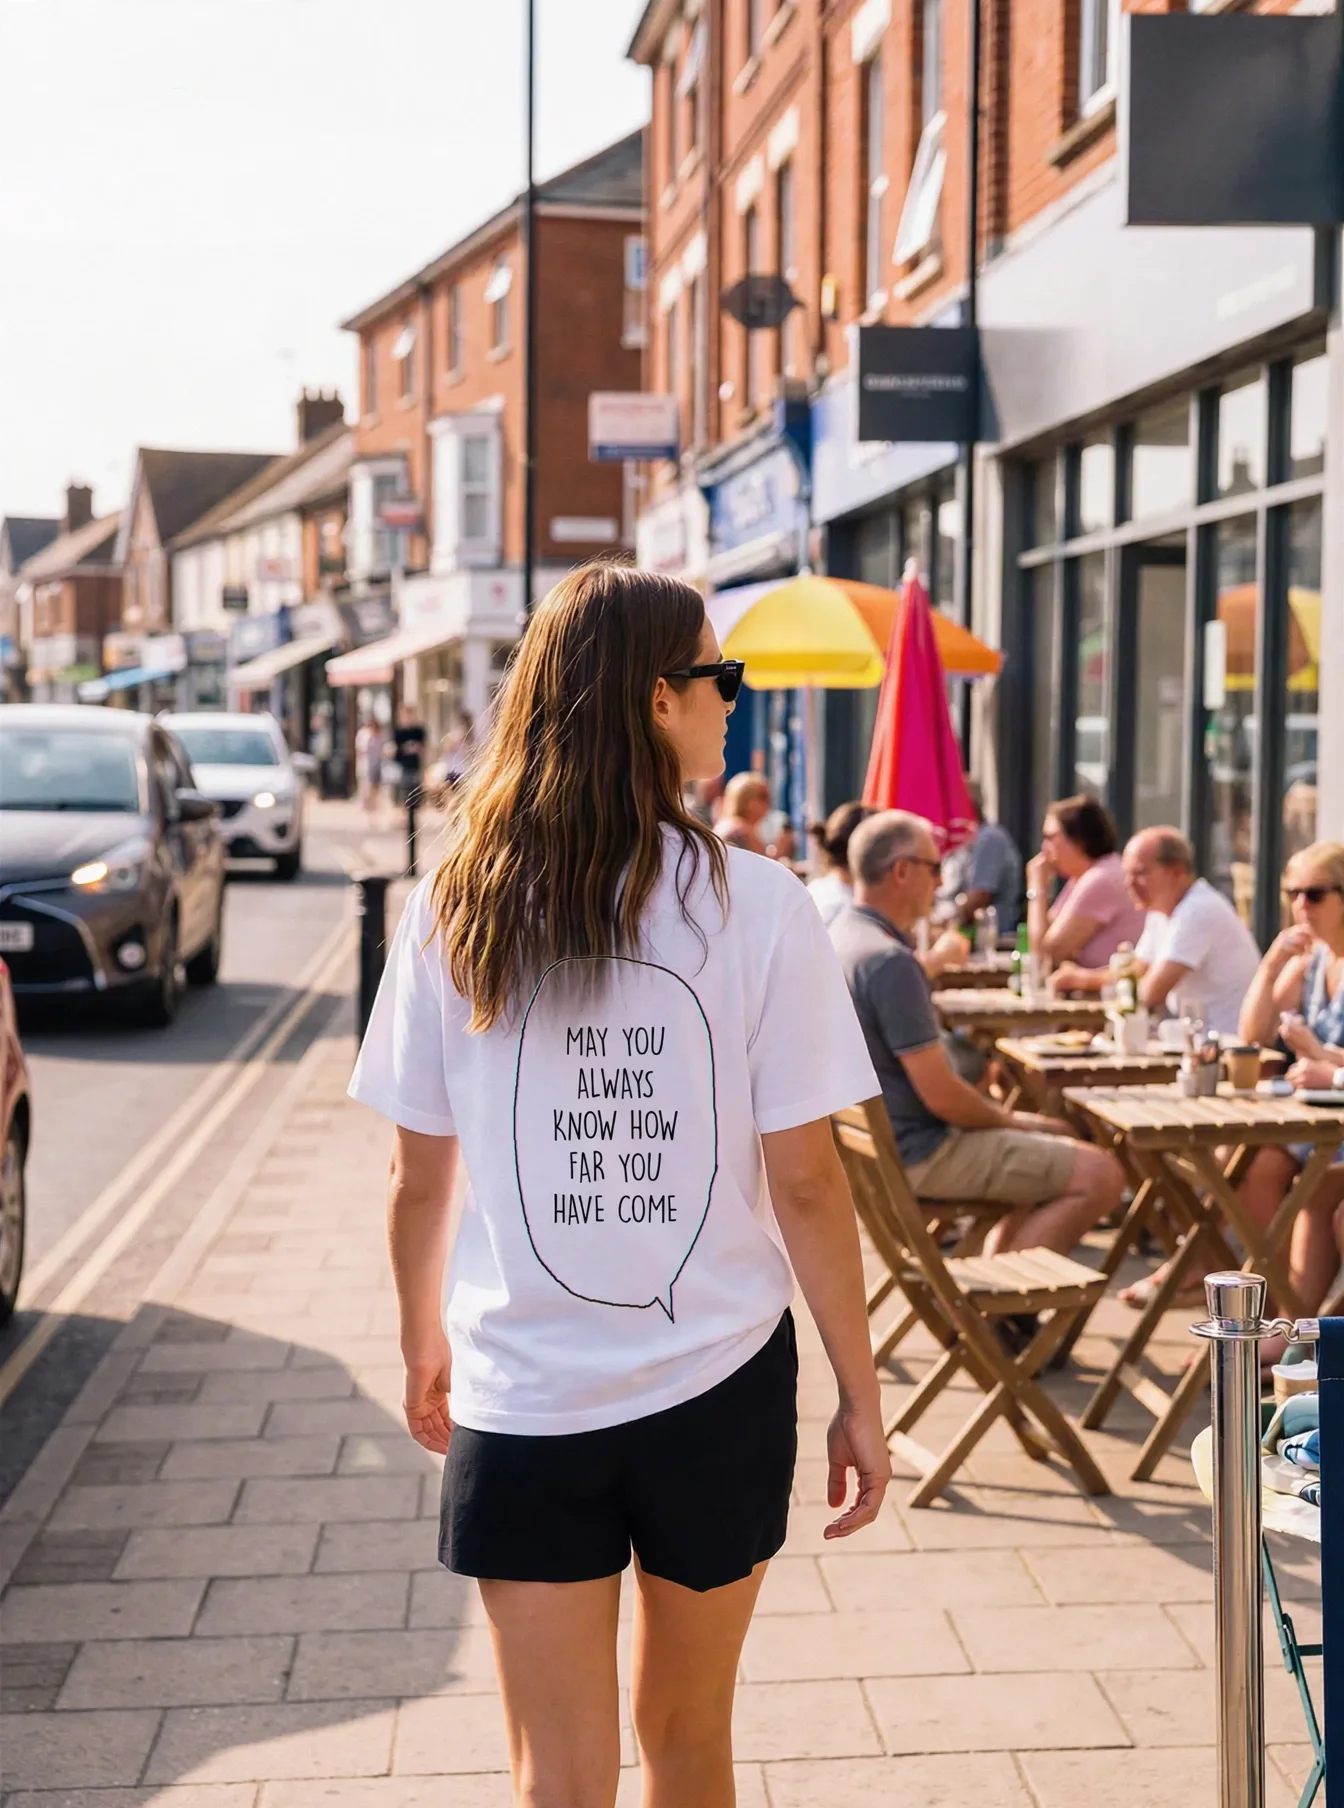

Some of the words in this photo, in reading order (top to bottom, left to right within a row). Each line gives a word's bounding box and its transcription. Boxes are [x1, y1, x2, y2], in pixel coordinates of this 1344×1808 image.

[566, 1026, 608, 1058] MAY
[622, 1026, 665, 1057] YOU
[577, 1067, 654, 1100] ALWAYS
[553, 1109, 617, 1142] KNOW
[630, 1109, 679, 1141] HOW
[569, 1150, 605, 1184] FAR
[618, 1152, 662, 1183] YOU
[553, 1193, 605, 1226] HAVE
[618, 1194, 678, 1224] COME
